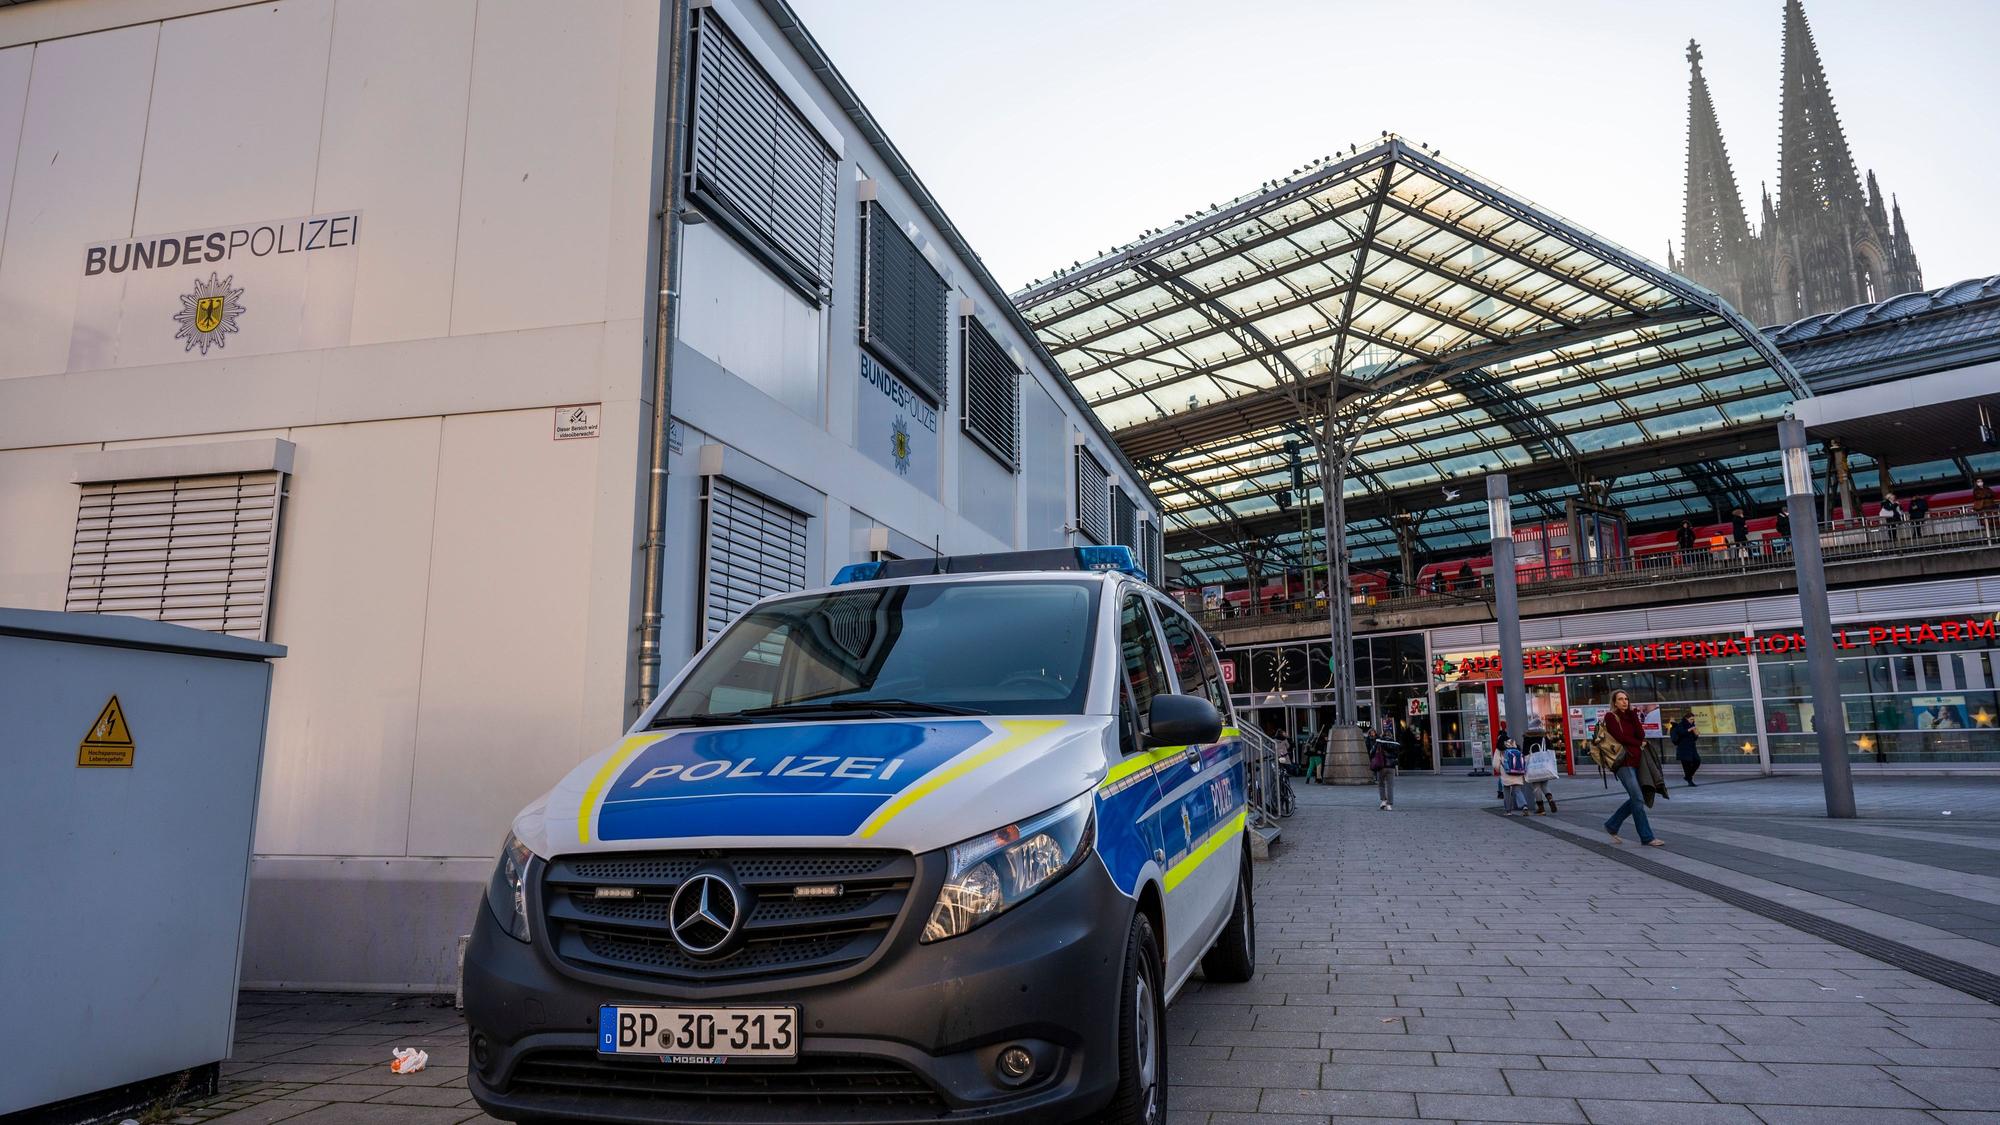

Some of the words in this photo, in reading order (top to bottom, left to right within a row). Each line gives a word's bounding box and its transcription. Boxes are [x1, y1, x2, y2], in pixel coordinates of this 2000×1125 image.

[85, 215, 358, 276] BUNDESPOLIZEI
[861, 353, 937, 434] BUNDESPOLIZEI
[1459, 649, 1578, 674] APOHEKE
[1619, 628, 1857, 662] INTERNATIONL
[1868, 618, 1996, 647] PHARM
[1221, 665, 1233, 680] B
[630, 756, 905, 788] POLIZEI
[605, 1034, 612, 1043] D
[619, 1012, 658, 1048] BP
[676, 1013, 792, 1050] 30-313
[672, 1056, 715, 1064] MOSOLF
